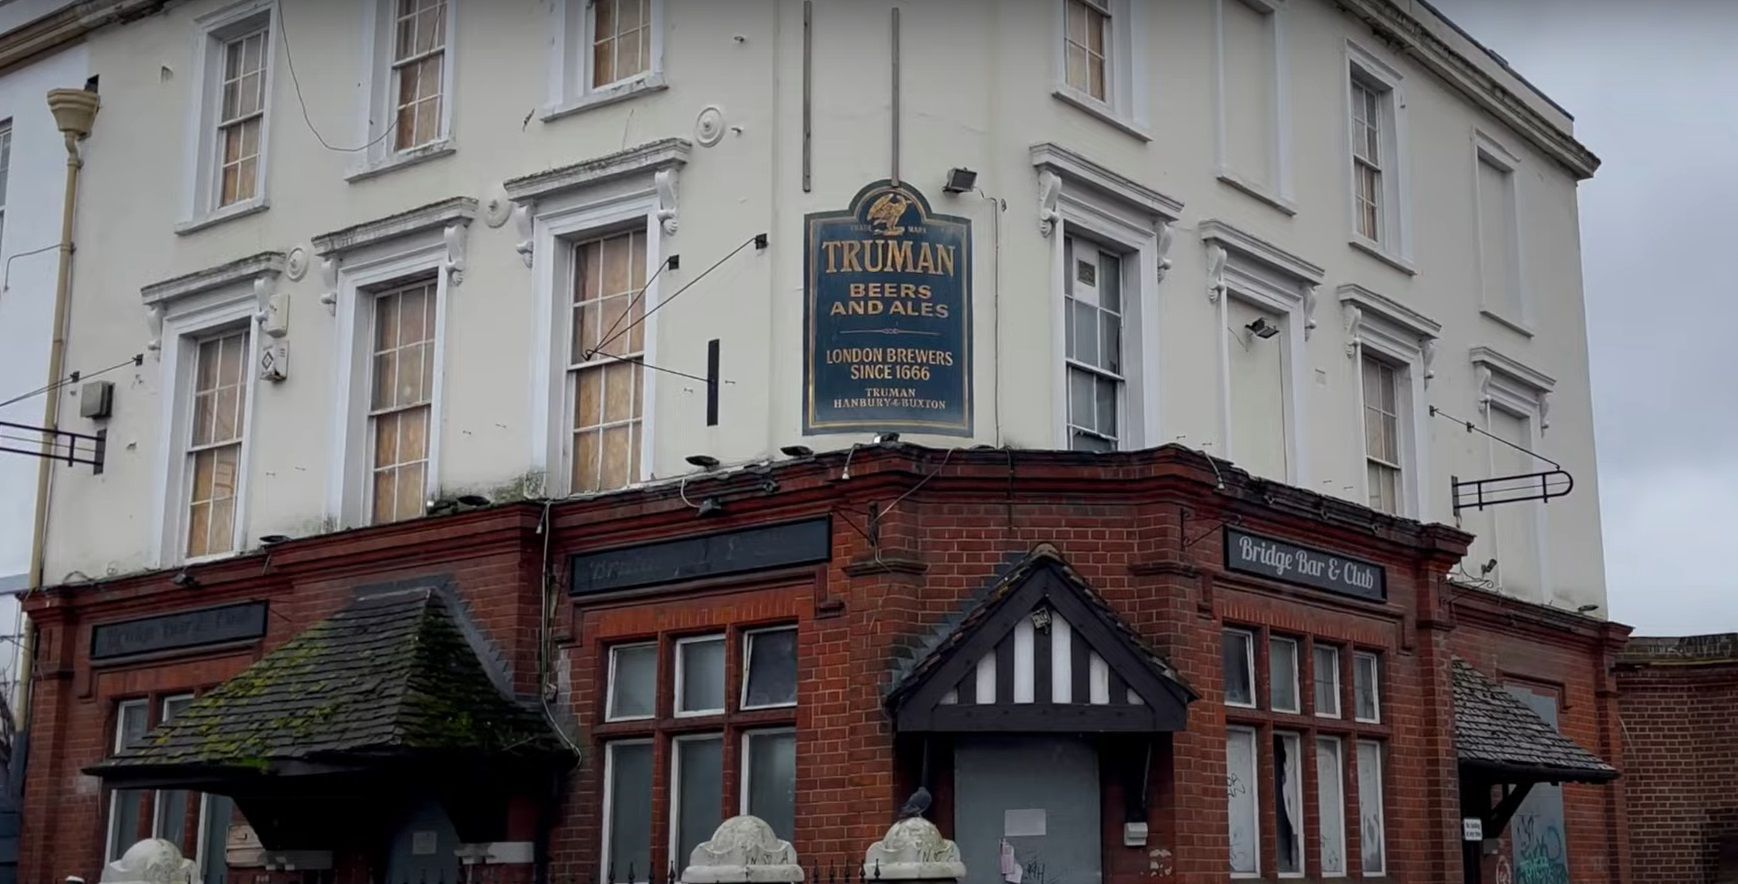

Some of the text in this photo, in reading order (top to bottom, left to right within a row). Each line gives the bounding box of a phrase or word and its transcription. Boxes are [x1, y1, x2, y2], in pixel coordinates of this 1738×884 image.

[822, 239, 955, 277] TRUMAN
[850, 283, 932, 299] BEERS
[830, 300, 949, 318] AND ALES
[826, 348, 953, 366] LONDON BREWERS
[851, 364, 930, 381] SINCE 1666
[865, 387, 916, 397] TRUMAN
[834, 398, 890, 409] HANBURY
[901, 399, 946, 409] BUXTON
[1239, 536, 1374, 589] Bridge Bar & Club
